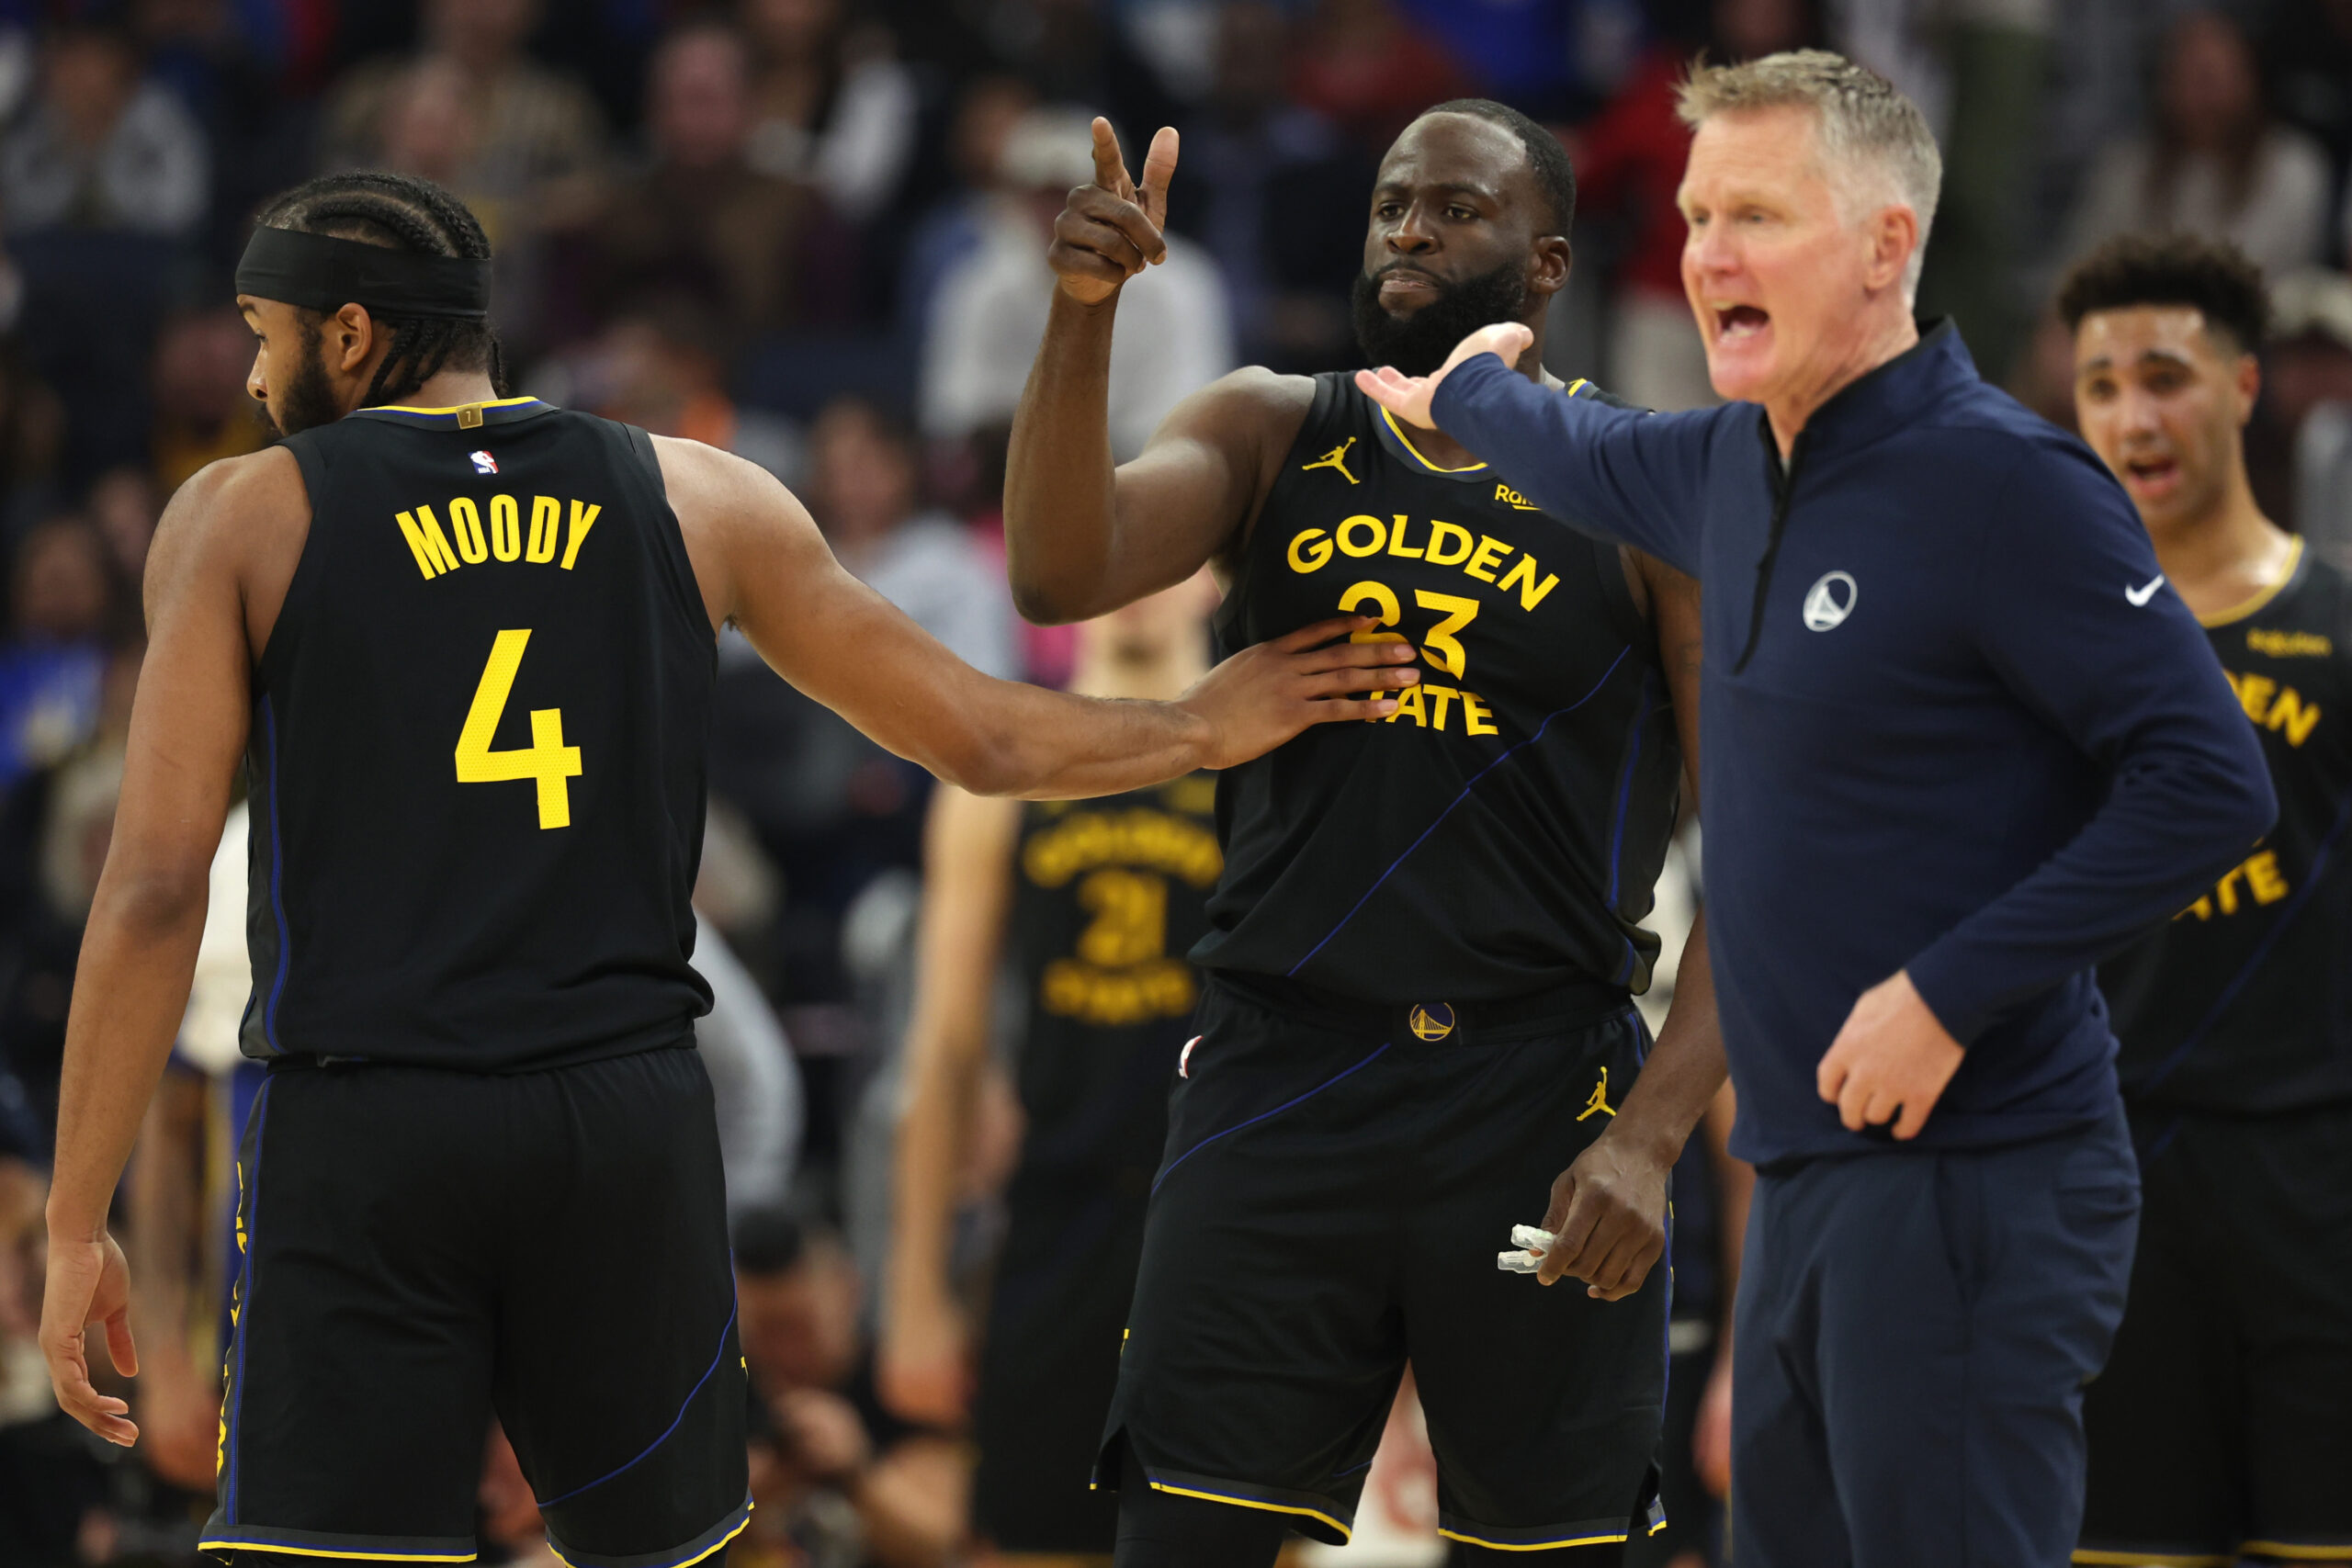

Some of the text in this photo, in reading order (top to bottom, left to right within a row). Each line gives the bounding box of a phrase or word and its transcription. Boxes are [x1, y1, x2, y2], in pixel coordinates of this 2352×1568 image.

[395, 494, 602, 581] MOODY
[1287, 514, 1560, 612] GOLDEN
[1338, 581, 1480, 681] 23
[455, 628, 583, 830] 4
[2223, 669, 2322, 747] EN
